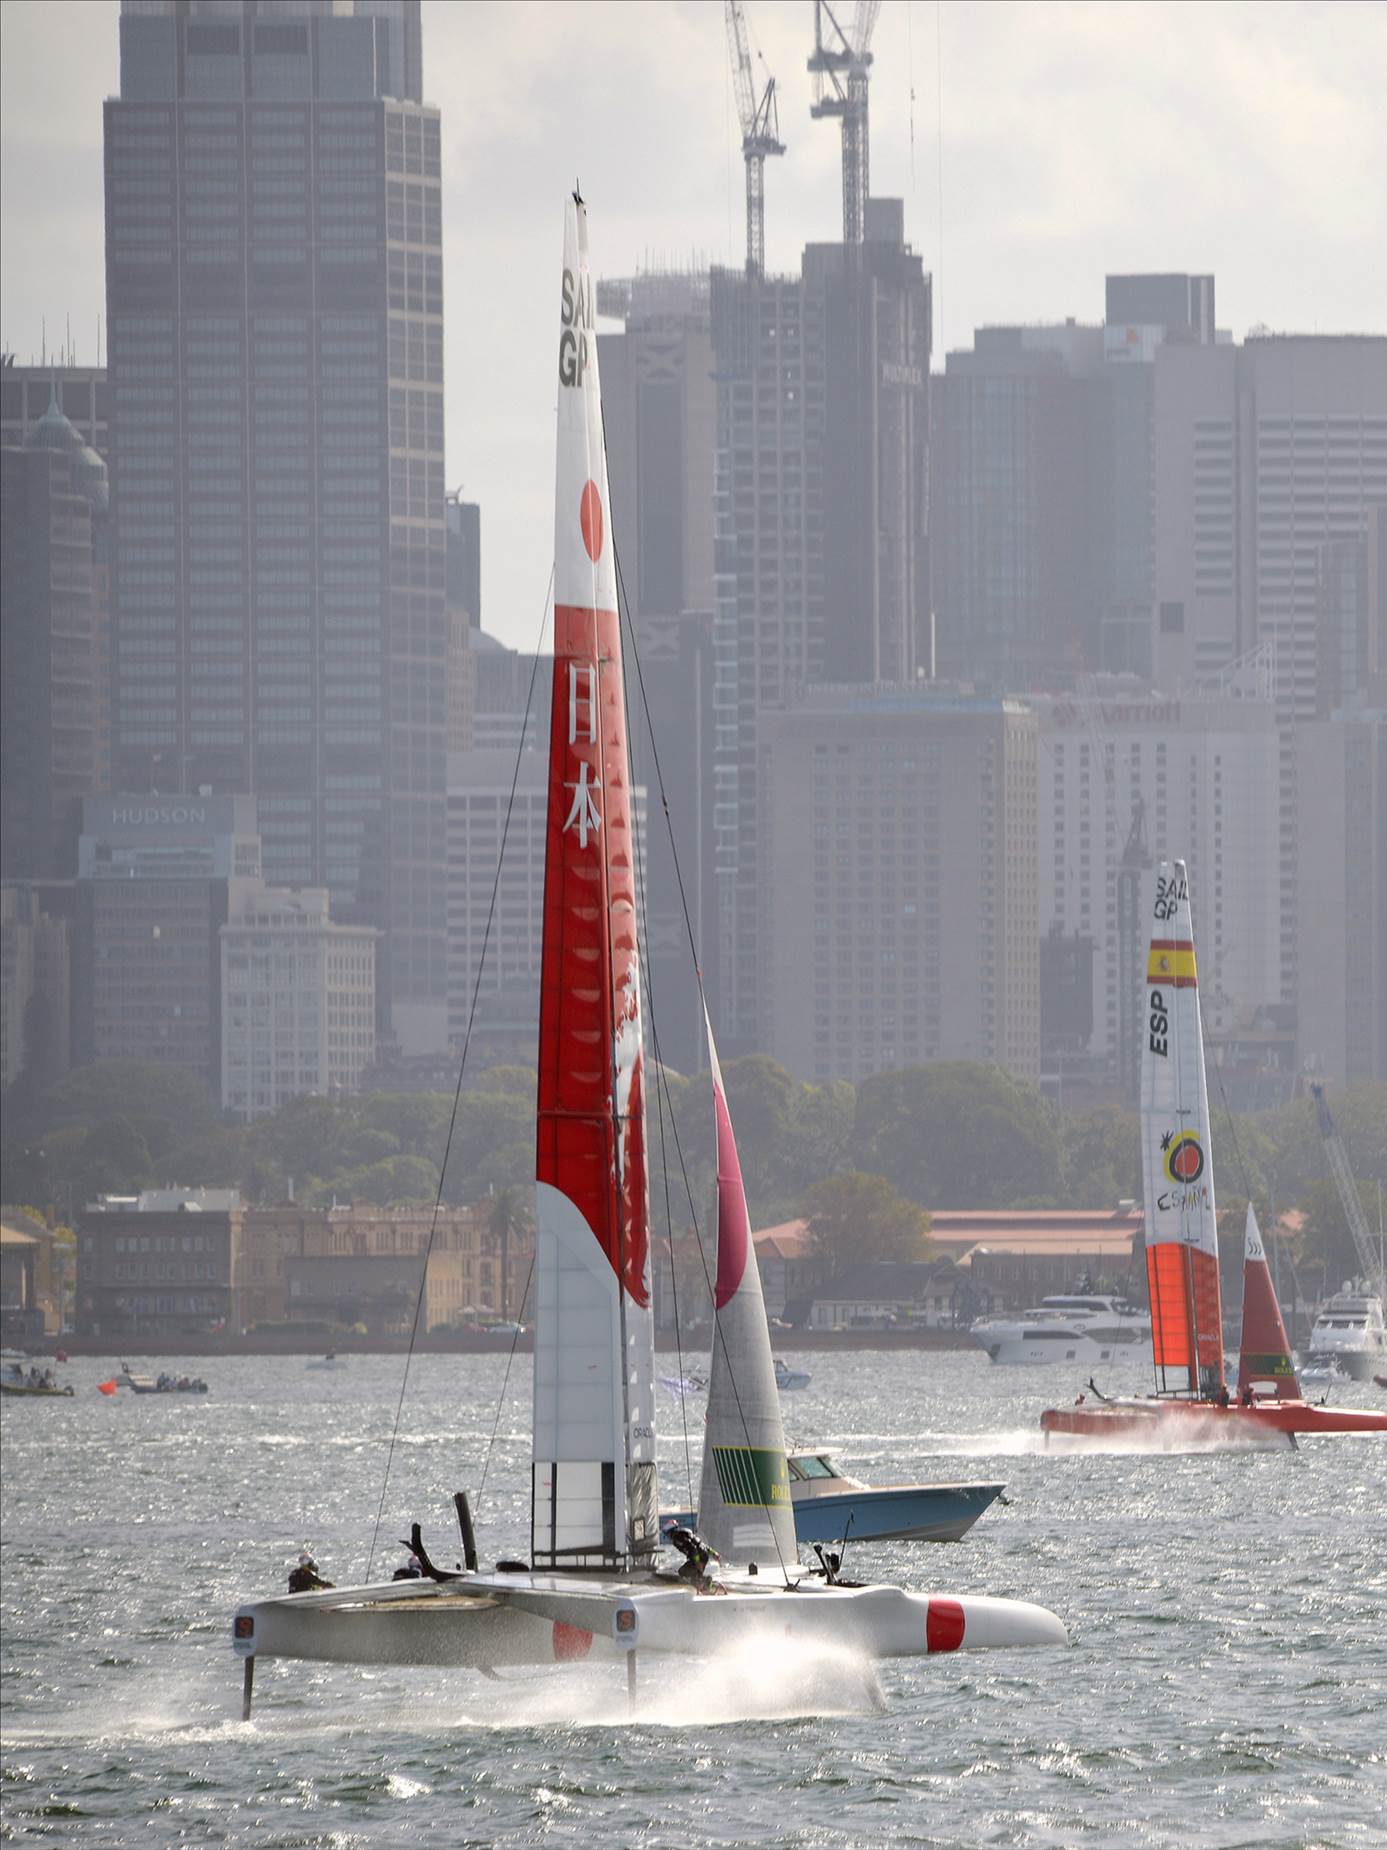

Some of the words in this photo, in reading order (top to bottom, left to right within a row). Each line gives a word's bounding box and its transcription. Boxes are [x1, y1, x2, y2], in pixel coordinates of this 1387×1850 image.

[558, 330, 588, 388] GP
[562, 662, 602, 850] 日本
[112, 808, 206, 824] HUDSON
[1156, 877, 1188, 900] SAIL
[1153, 899, 1178, 920] GP
[1150, 990, 1168, 1057] ESP
